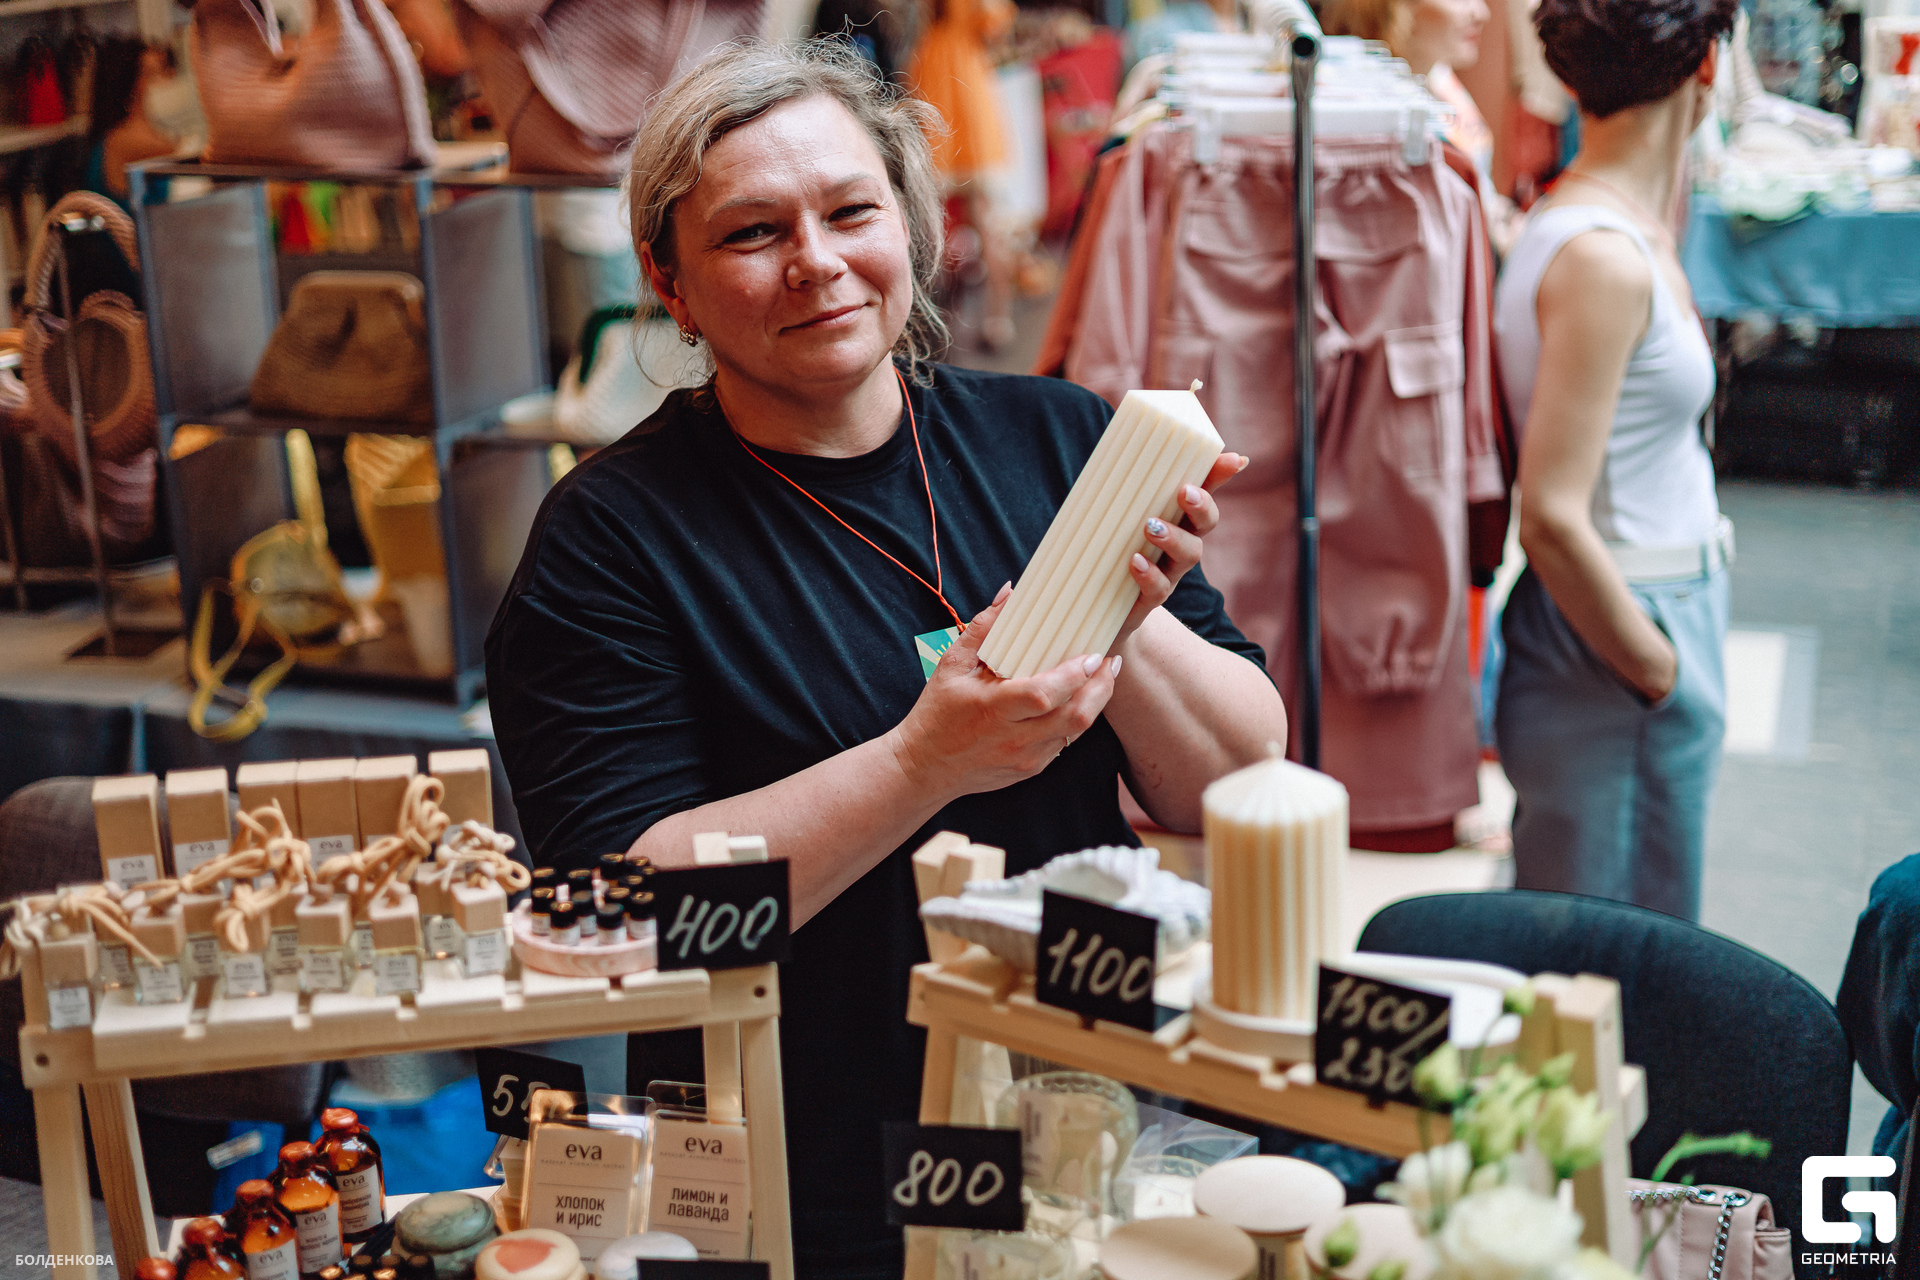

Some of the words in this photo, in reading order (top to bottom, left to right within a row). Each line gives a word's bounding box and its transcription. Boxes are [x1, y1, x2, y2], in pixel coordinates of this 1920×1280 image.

[189, 841, 216, 854] eva
[319, 838, 343, 850] eva
[121, 860, 145, 870] eva
[665, 894, 779, 959] 400
[1046, 927, 1153, 1003] 1100
[565, 1143, 603, 1161] eva
[685, 1136, 723, 1155] eva
[342, 1174, 366, 1188] eva
[893, 1149, 1005, 1207] 800
[555, 1195, 606, 1212] хлопок
[671, 1186, 715, 1204] лимон
[719, 1192, 729, 1206] и
[304, 1211, 328, 1226] eva
[556, 1210, 565, 1224] и
[568, 1211, 603, 1230] ирис
[667, 1202, 730, 1223] лаванда
[259, 1250, 284, 1264] eva
